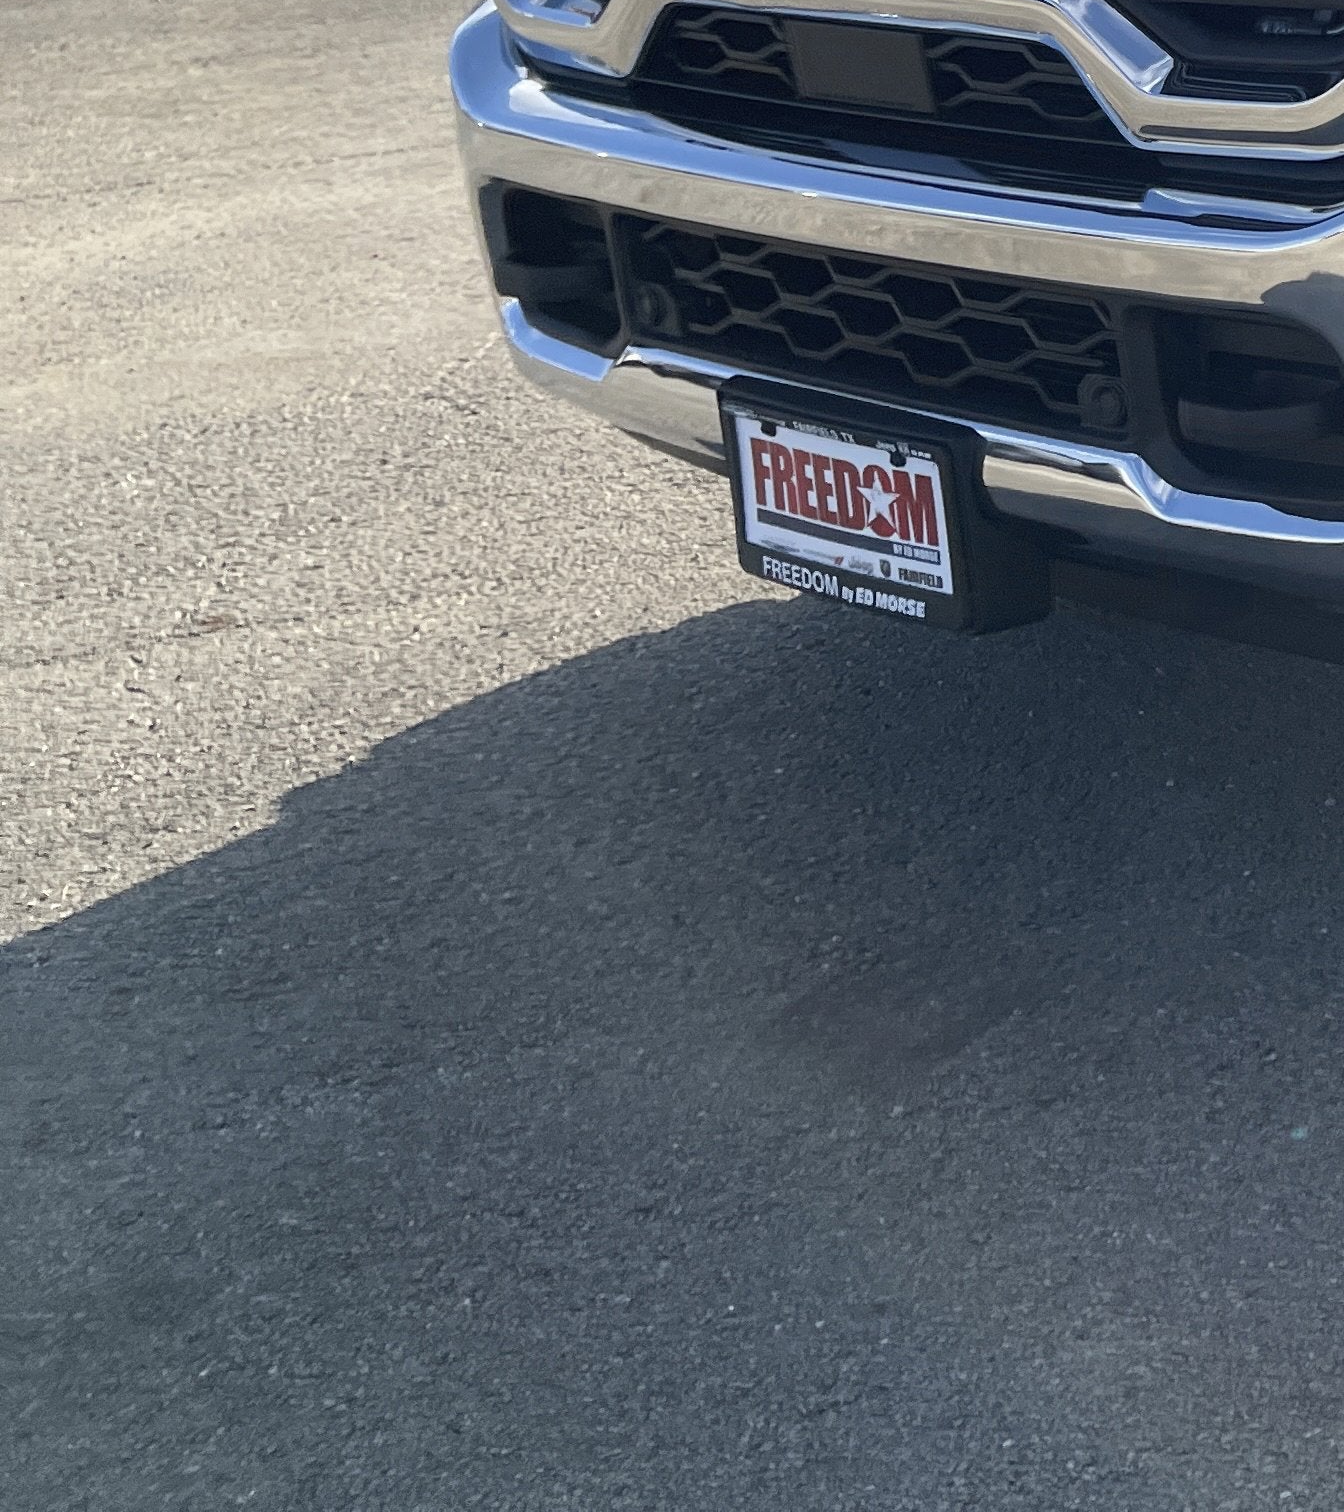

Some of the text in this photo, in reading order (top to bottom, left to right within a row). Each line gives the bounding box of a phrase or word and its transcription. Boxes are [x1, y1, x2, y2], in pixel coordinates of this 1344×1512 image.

[750, 437, 940, 547] FREEDOM
[762, 555, 839, 597] FREEDOM
[856, 587, 874, 606] ED
[875, 591, 926, 618] MORSE
